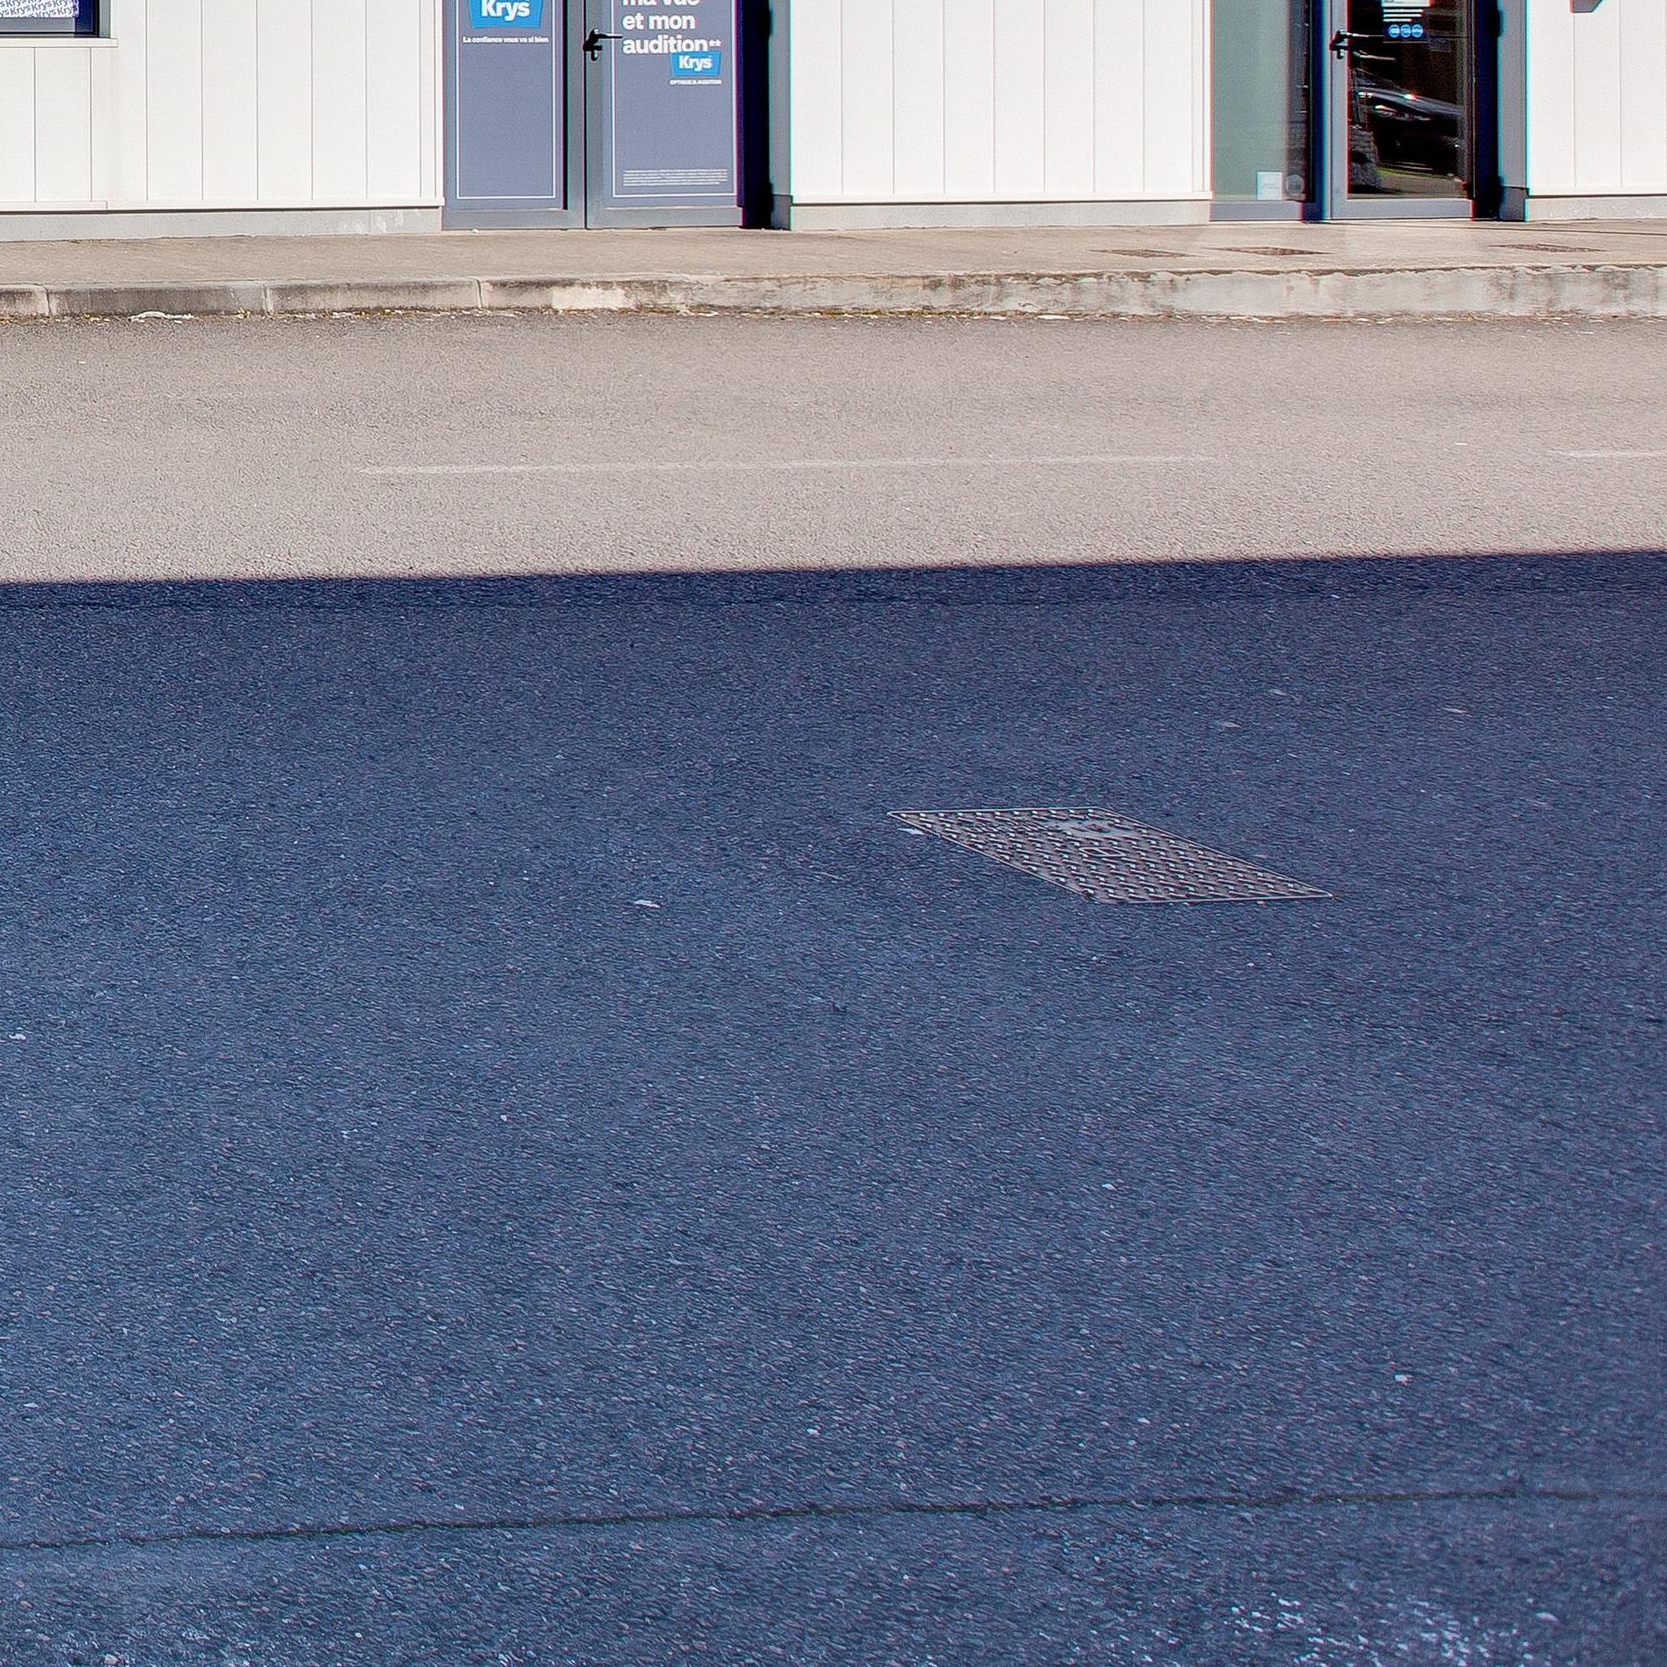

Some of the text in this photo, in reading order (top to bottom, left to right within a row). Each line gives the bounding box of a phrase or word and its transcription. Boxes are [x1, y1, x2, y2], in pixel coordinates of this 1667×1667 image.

[622, 12, 695, 30] et mon
[678, 55, 713, 72] Krys
